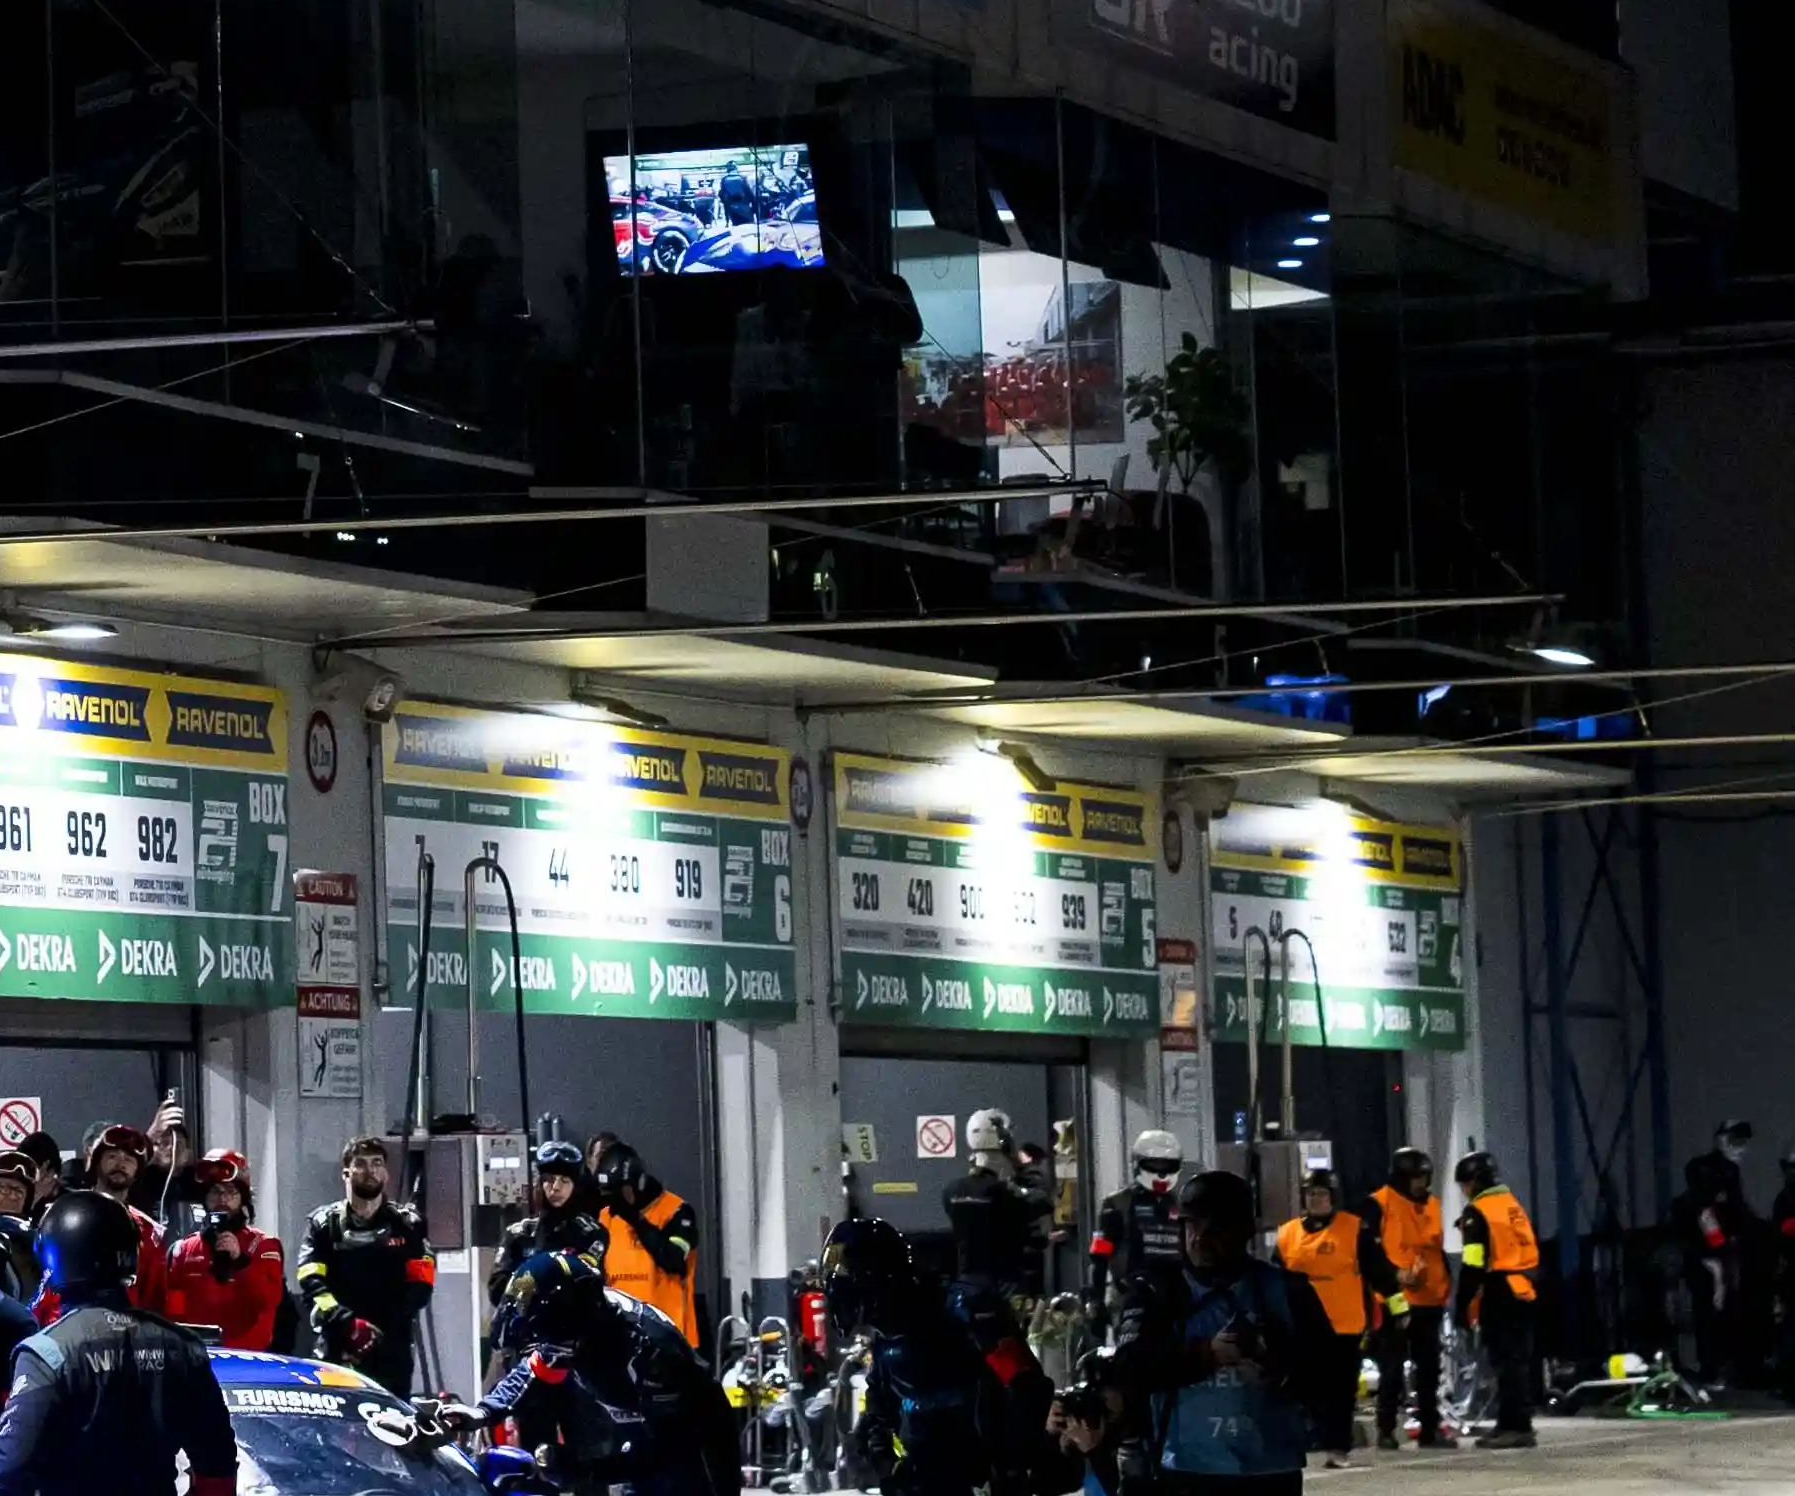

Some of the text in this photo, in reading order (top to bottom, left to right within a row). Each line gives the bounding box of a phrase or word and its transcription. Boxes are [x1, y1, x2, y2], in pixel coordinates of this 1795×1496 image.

[46, 691, 140, 727] RAVENOL
[177, 707, 264, 739] RAVENOL
[706, 763, 771, 793] RAVENOL
[248, 782, 286, 824] BOX
[67, 811, 107, 858] 962
[138, 816, 178, 864] 982
[761, 830, 790, 865] BOX
[266, 835, 286, 912] 7
[482, 840, 499, 883] 17
[548, 848, 569, 890] 44
[675, 858, 701, 900] 919
[308, 880, 344, 897] CAUTION
[852, 872, 879, 912] 320
[907, 877, 933, 917] 420
[774, 875, 792, 942] 6
[1061, 894, 1086, 930] 939
[16, 933, 76, 972] DEKRA
[121, 938, 177, 977] DEKRA
[221, 945, 273, 980] DEKRA
[588, 959, 634, 994] DEKRA
[666, 963, 709, 997] DEKRA
[742, 968, 781, 1000] DEKRA
[872, 975, 908, 1004] DEKRA
[935, 979, 972, 1009] DEKRA
[308, 993, 350, 1012] ACHTUNG
[1057, 987, 1092, 1016] DEKRA
[1116, 992, 1148, 1019] DEKRA
[857, 1124, 874, 1162] STOP
[232, 1390, 339, 1410] TURISMO
